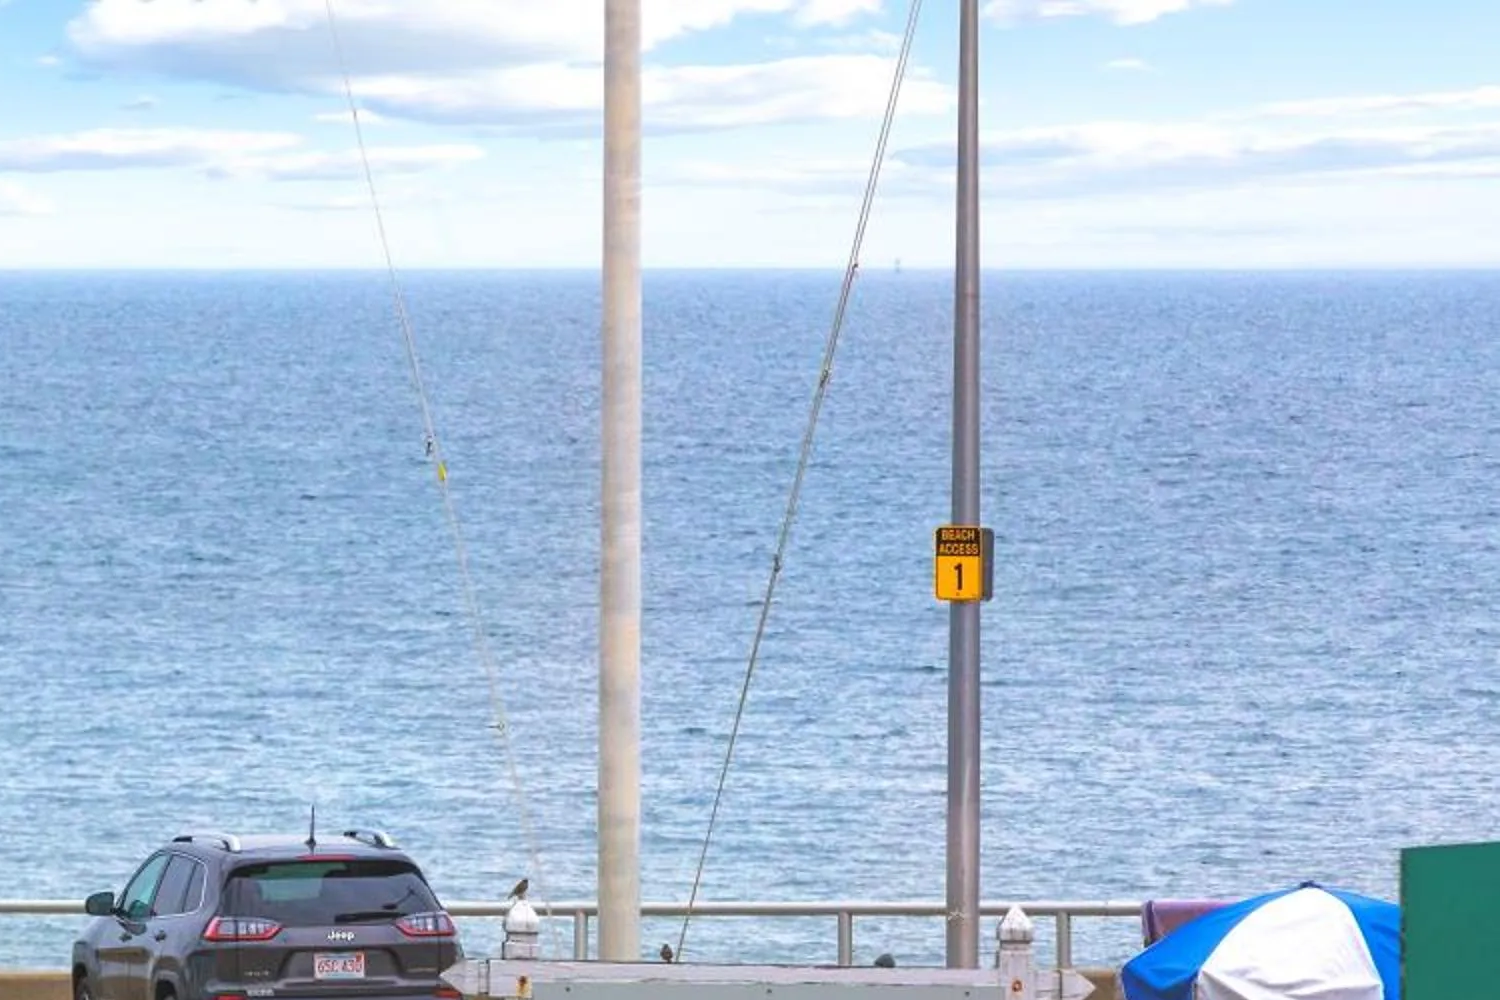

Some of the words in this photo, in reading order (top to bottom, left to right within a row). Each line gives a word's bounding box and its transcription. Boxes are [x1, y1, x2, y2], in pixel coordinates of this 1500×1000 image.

[941, 529, 975, 541] BEACH
[939, 543, 979, 555] ACCESS
[953, 562, 963, 591] 1
[326, 929, 355, 941] Jeep
